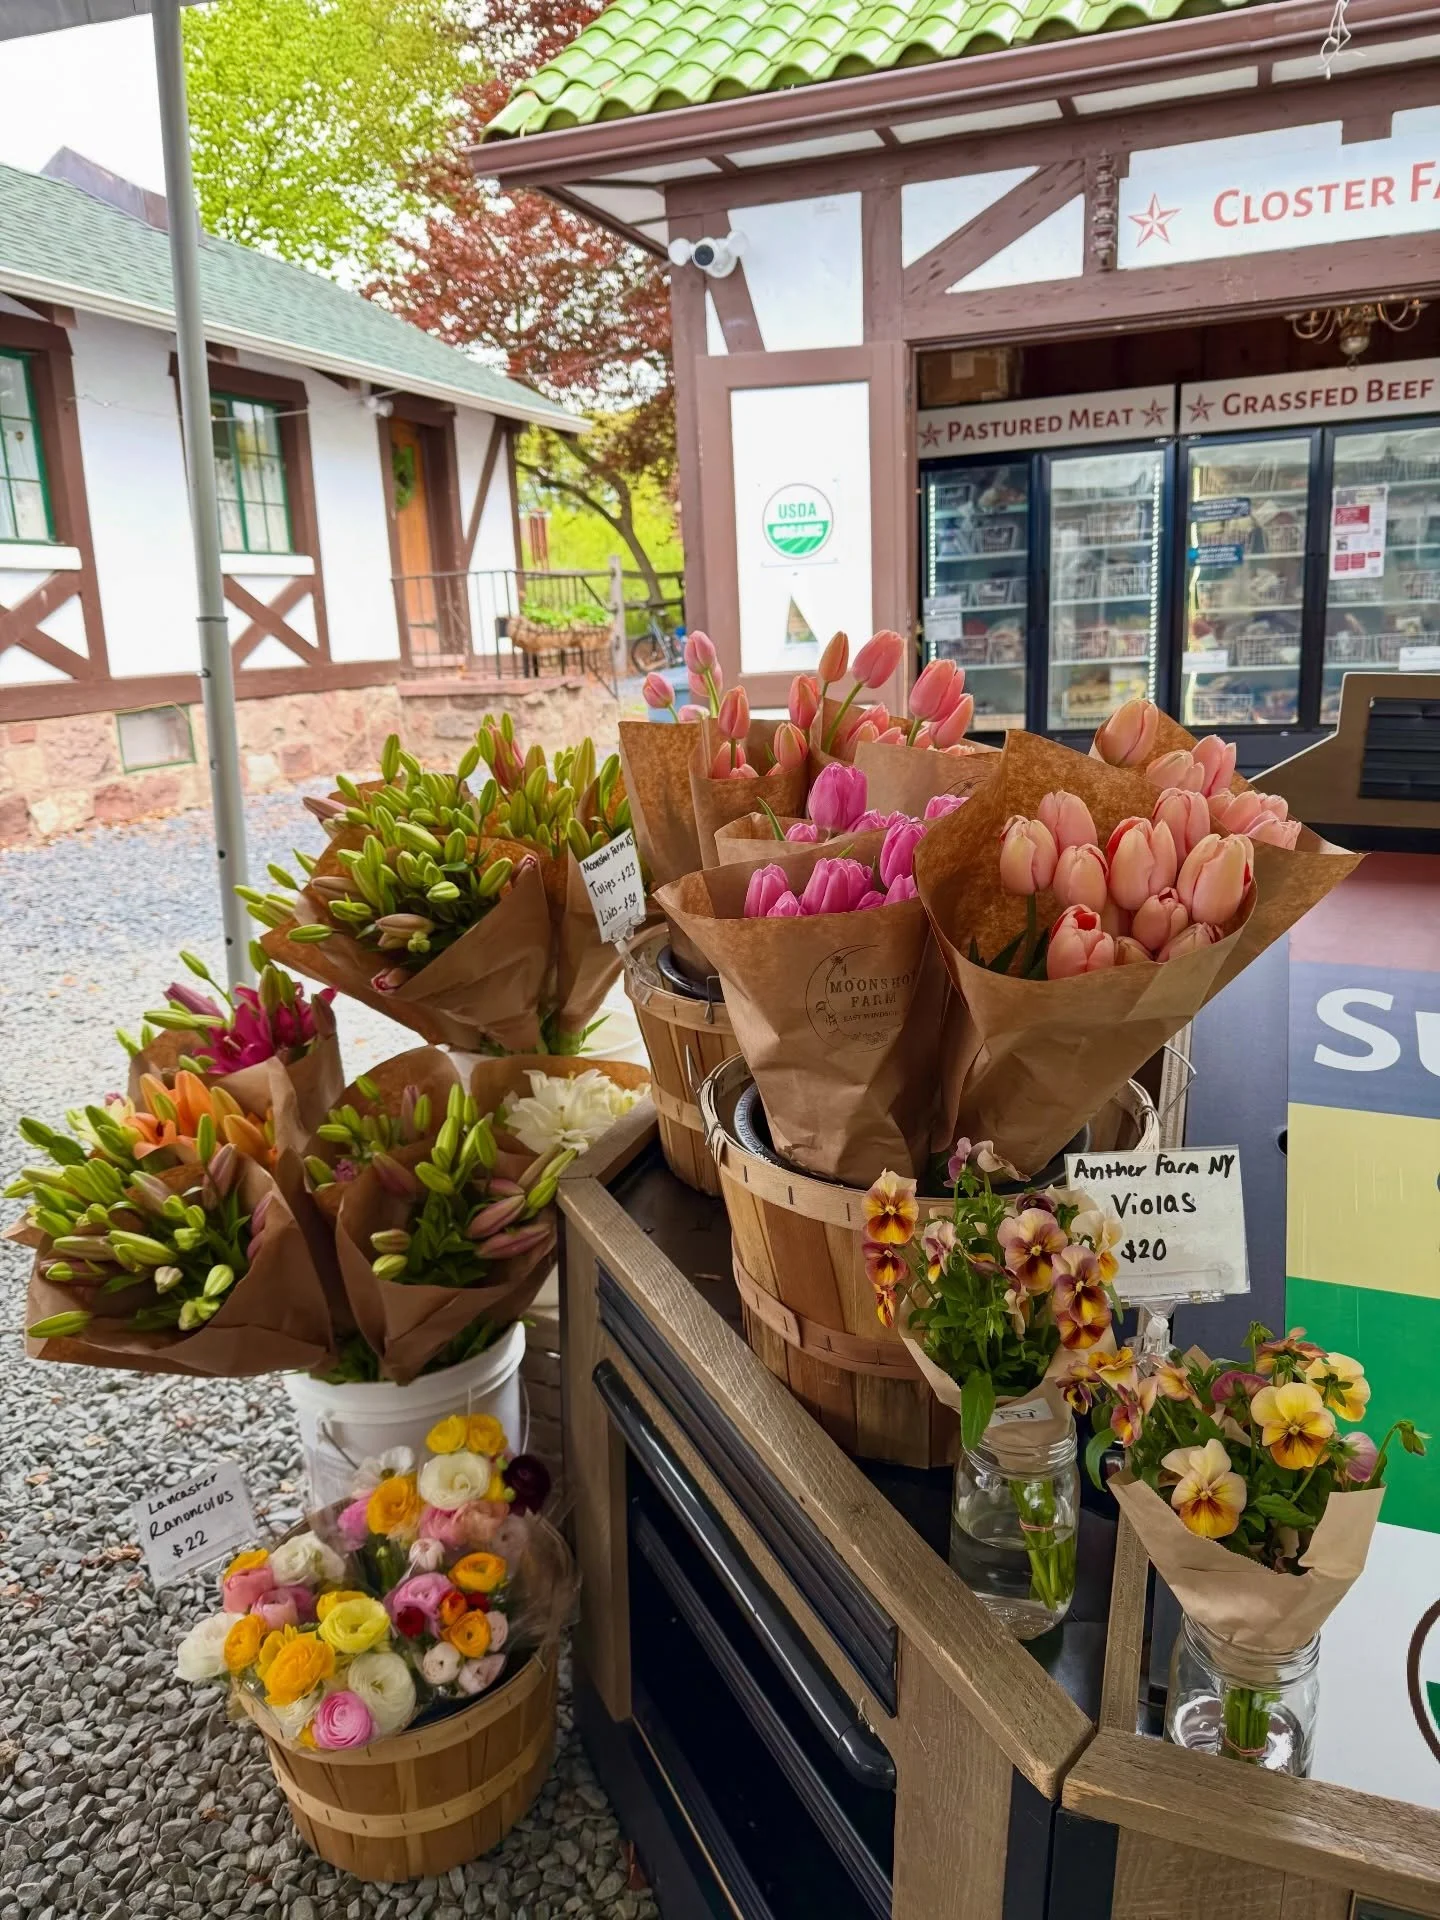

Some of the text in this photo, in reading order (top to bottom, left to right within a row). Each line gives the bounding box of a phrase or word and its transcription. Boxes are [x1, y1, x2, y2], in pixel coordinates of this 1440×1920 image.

[1213, 176, 1395, 227] CLOSTER
[1222, 379, 1435, 416] GRASSFED BEEF
[947, 407, 1134, 442] PASTURED MEAT
[778, 502, 817, 519] USDA
[589, 878, 616, 897] Tulips
[851, 992, 896, 1008] FARM
[1074, 1154, 1235, 1179] Anther Farm NY
[1111, 1192, 1196, 1218] Violas
[1121, 1238, 1167, 1263] $20
[148, 1472, 218, 1515] Lancaster
[172, 1530, 208, 1558] $22
